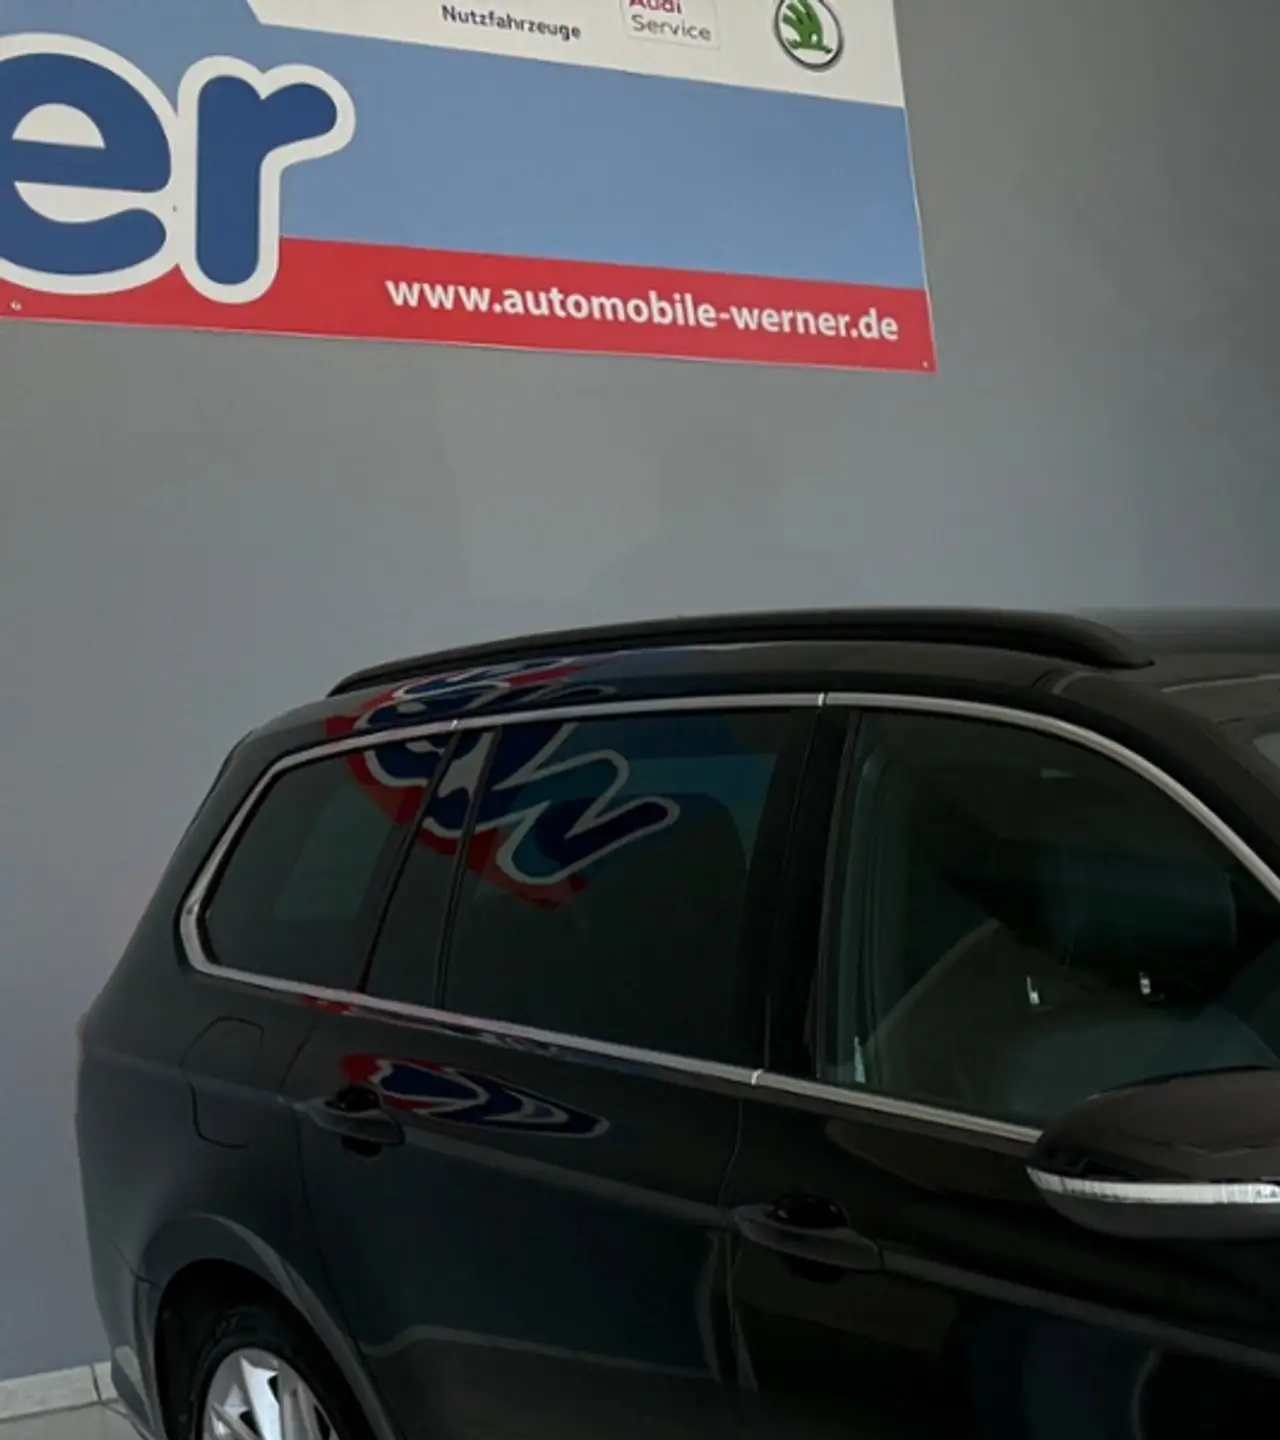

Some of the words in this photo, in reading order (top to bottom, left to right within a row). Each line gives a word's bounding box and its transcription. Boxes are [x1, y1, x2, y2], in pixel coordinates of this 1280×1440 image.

[441, 5, 581, 41] Nutzfahrzeuge
[631, 13, 711, 42] Service
[385, 278, 899, 342] www.automobile-werner.de
